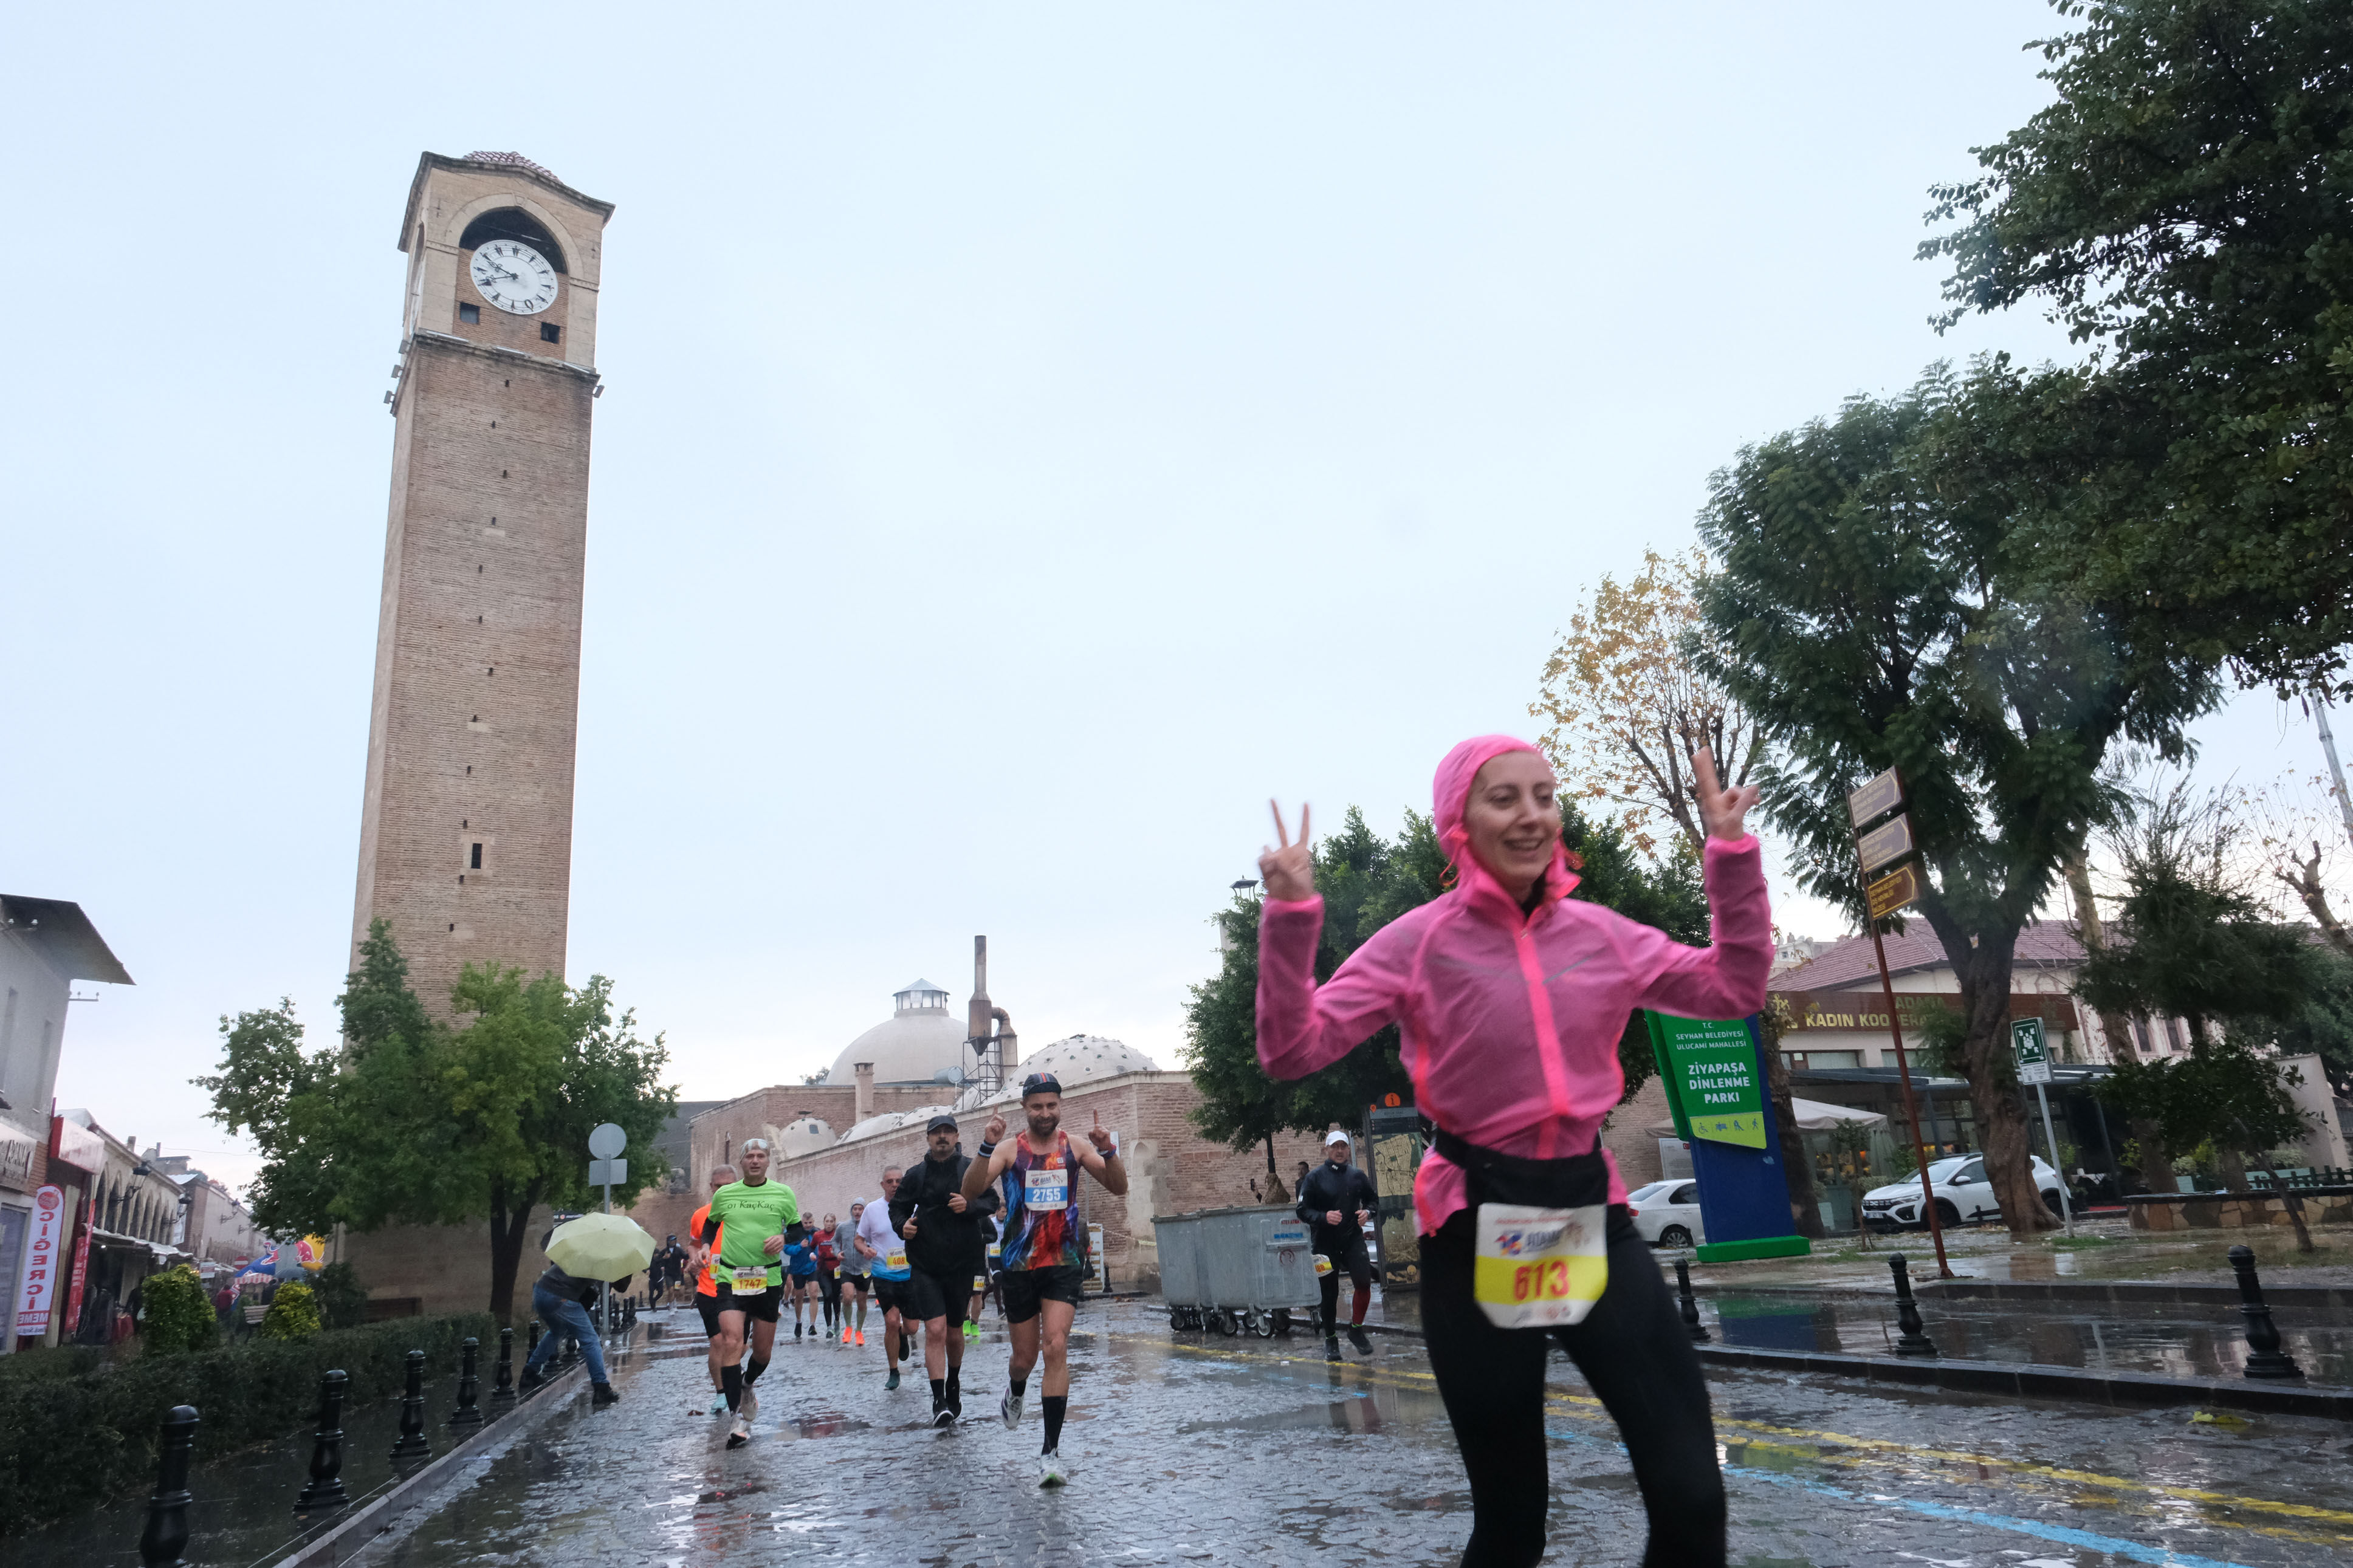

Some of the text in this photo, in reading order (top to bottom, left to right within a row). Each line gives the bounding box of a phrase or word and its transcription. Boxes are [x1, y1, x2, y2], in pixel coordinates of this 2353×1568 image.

[1806, 1013, 1854, 1027] KADIN
[1705, 1029, 1743, 1039] BELEDİYESİ
[1676, 1039, 1747, 1050] ULUCAMİ MAHALLESİ
[1688, 1061, 1747, 1076] ZİYAPAŞA
[1689, 1076, 1751, 1090] DİNLENME
[1704, 1092, 1740, 1104] PARKI
[1032, 1188, 1061, 1202] 2755
[738, 1279, 761, 1289] 1747
[1514, 1261, 1570, 1301] 613
